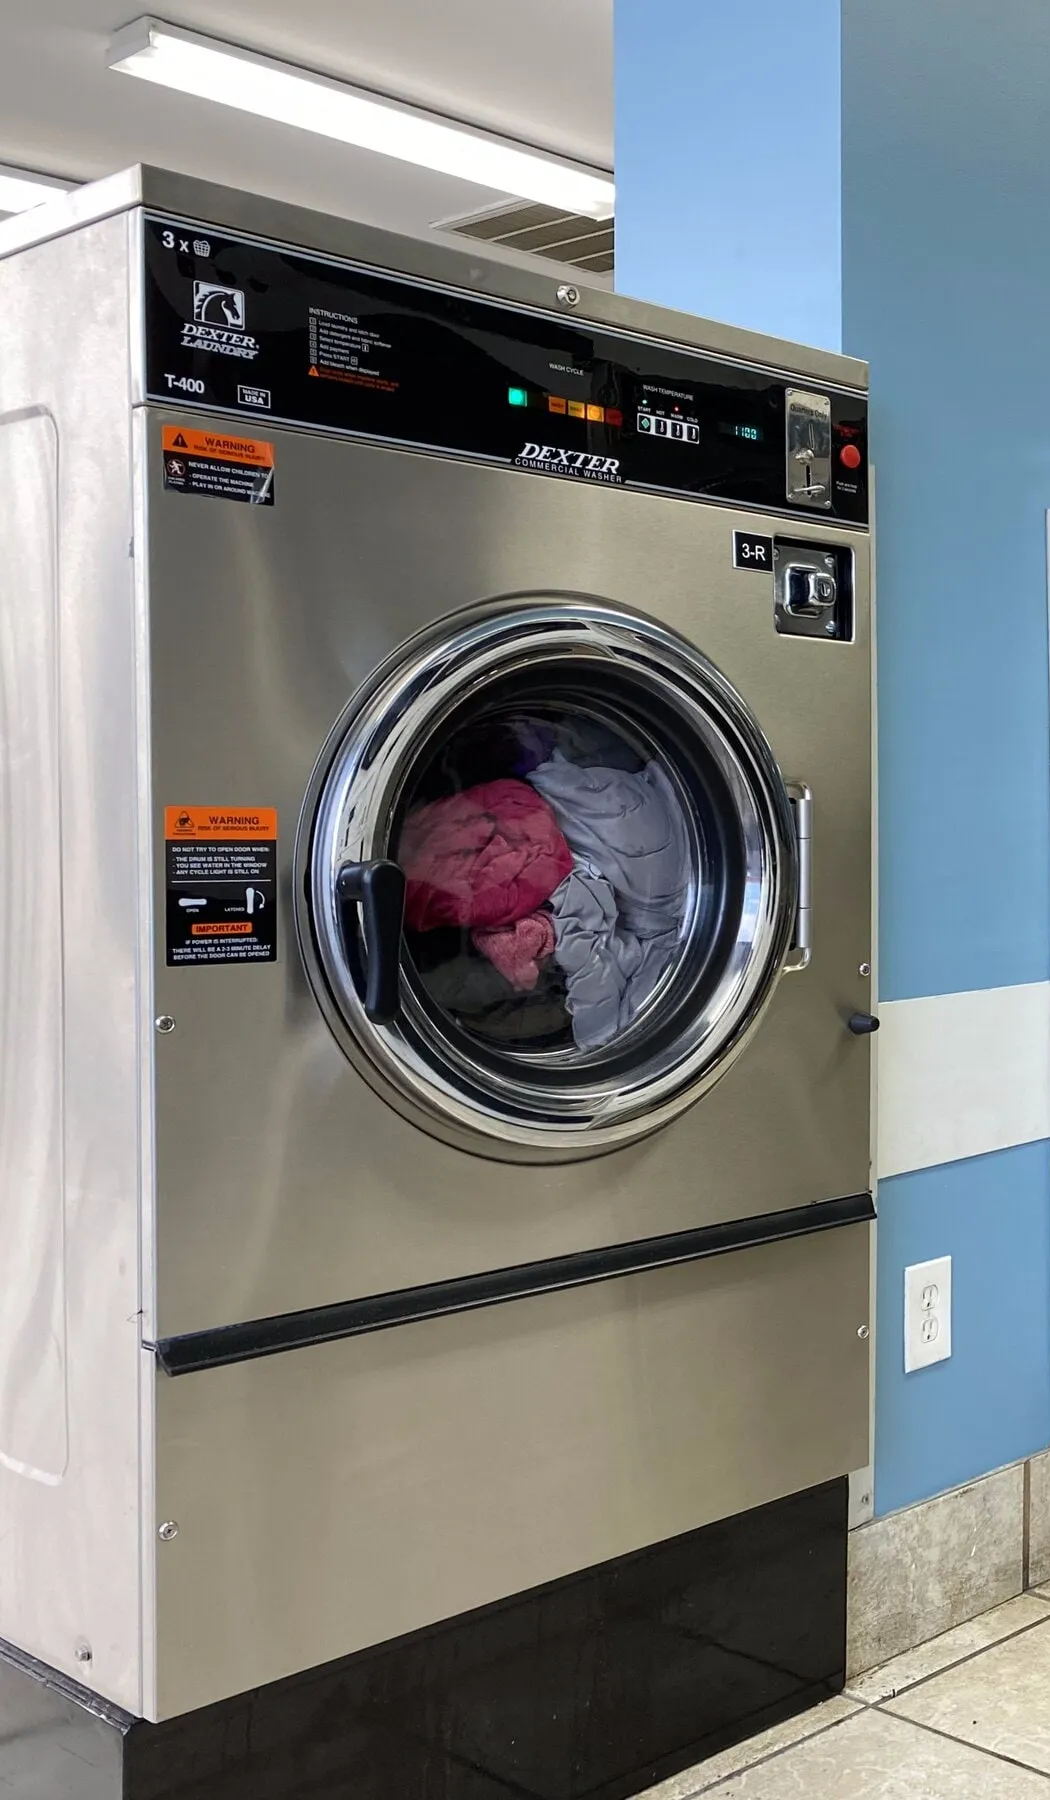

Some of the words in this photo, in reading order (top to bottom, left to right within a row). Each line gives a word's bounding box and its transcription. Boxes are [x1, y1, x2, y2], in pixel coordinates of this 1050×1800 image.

[162, 231, 175, 248] 3
[179, 239, 189, 252] x
[309, 307, 358, 324] INSTRUCTIONS
[180, 323, 255, 349] DEXTER
[180, 336, 259, 360] LAUNDRY
[549, 363, 565, 372] WASH
[566, 366, 585, 376] CYCLE
[164, 373, 205, 394] T-400
[245, 395, 264, 405] USA
[643, 384, 658, 394] WASH
[658, 387, 694, 401] TEMPERATURE
[790, 403, 814, 417] Quarters
[815, 409, 828, 419] Only
[205, 436, 255, 454] WARNING
[518, 442, 620, 474] DEXTER
[188, 461, 209, 470] NEVER
[209, 465, 231, 474] ALLOW
[231, 468, 260, 478] CHILDREN
[514, 457, 580, 476] COMMERCIAL
[583, 470, 622, 484] WASHER
[192, 473, 217, 482] OPERATE
[219, 476, 229, 484] THE
[230, 478, 254, 488] MACHINE
[192, 481, 207, 489] PLAY
[223, 486, 246, 495] AROUND
[742, 543, 766, 561] 3-R
[209, 816, 260, 825] WARNING
[195, 924, 248, 933] IMPORTANT
